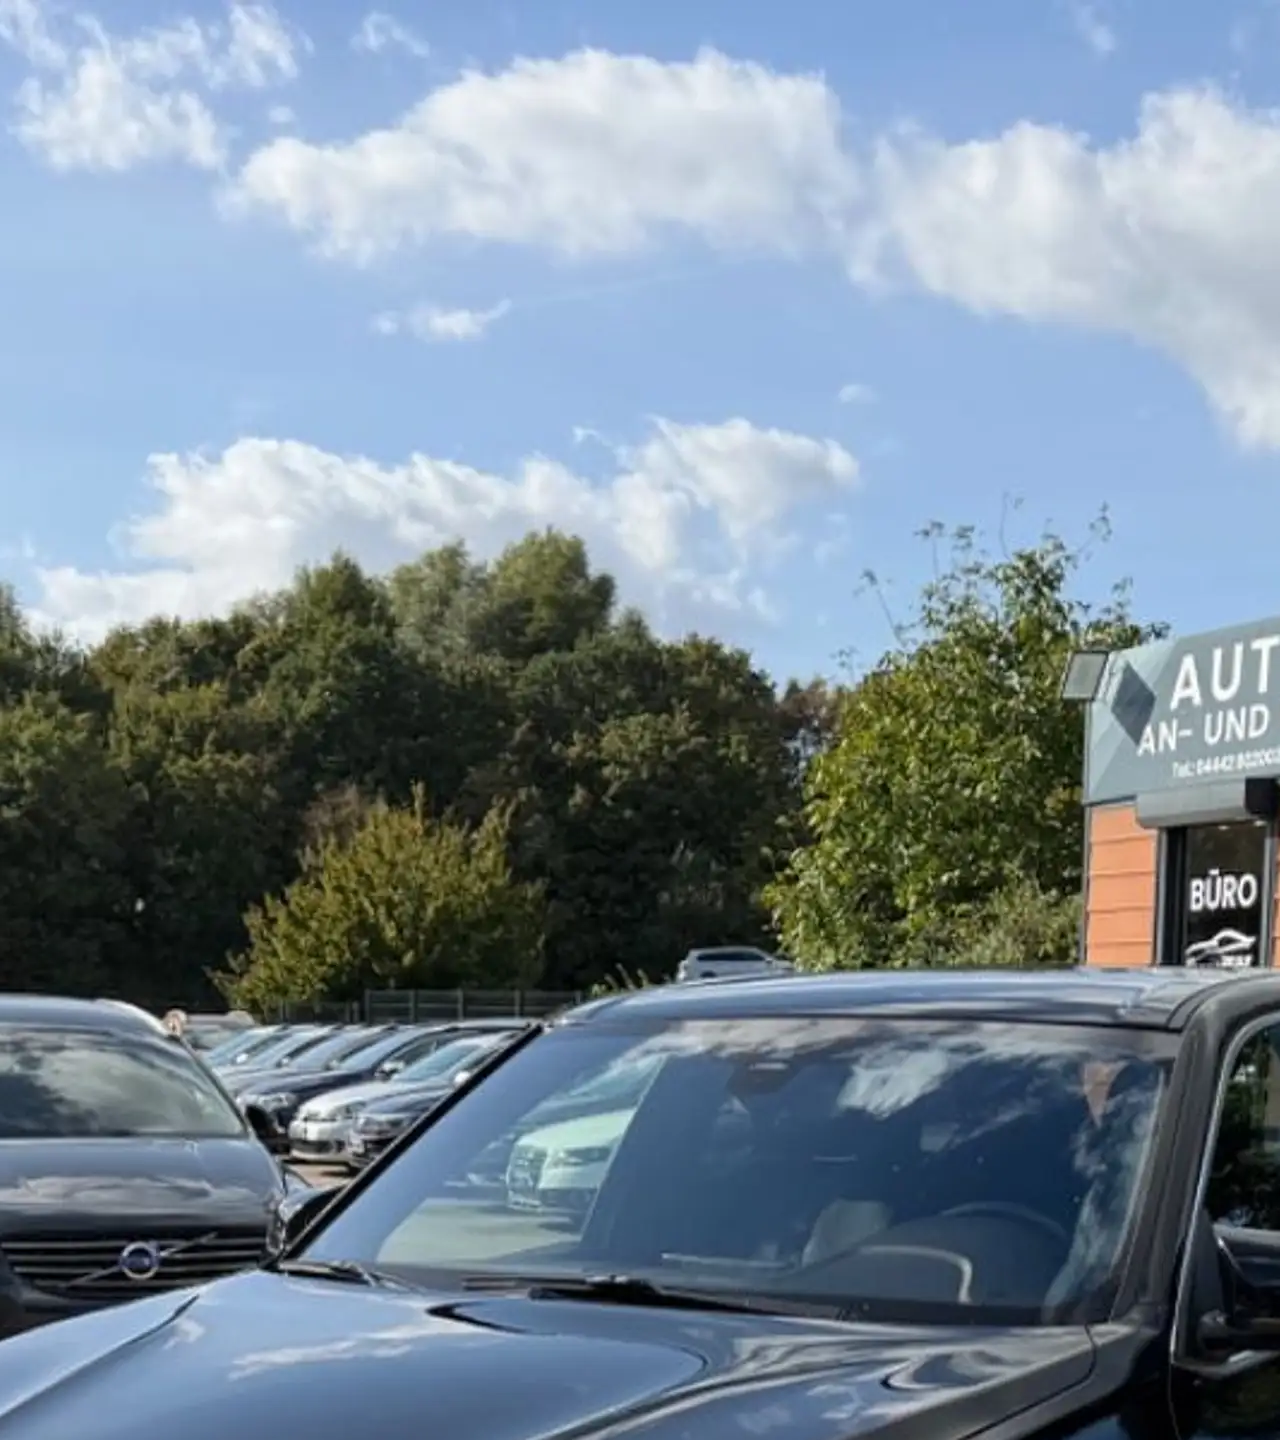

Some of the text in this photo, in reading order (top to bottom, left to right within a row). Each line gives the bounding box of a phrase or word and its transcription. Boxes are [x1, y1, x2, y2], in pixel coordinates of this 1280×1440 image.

[1137, 718, 1193, 755] AN-
[1203, 705, 1270, 745] UND
[1190, 868, 1258, 912] BÜRO
